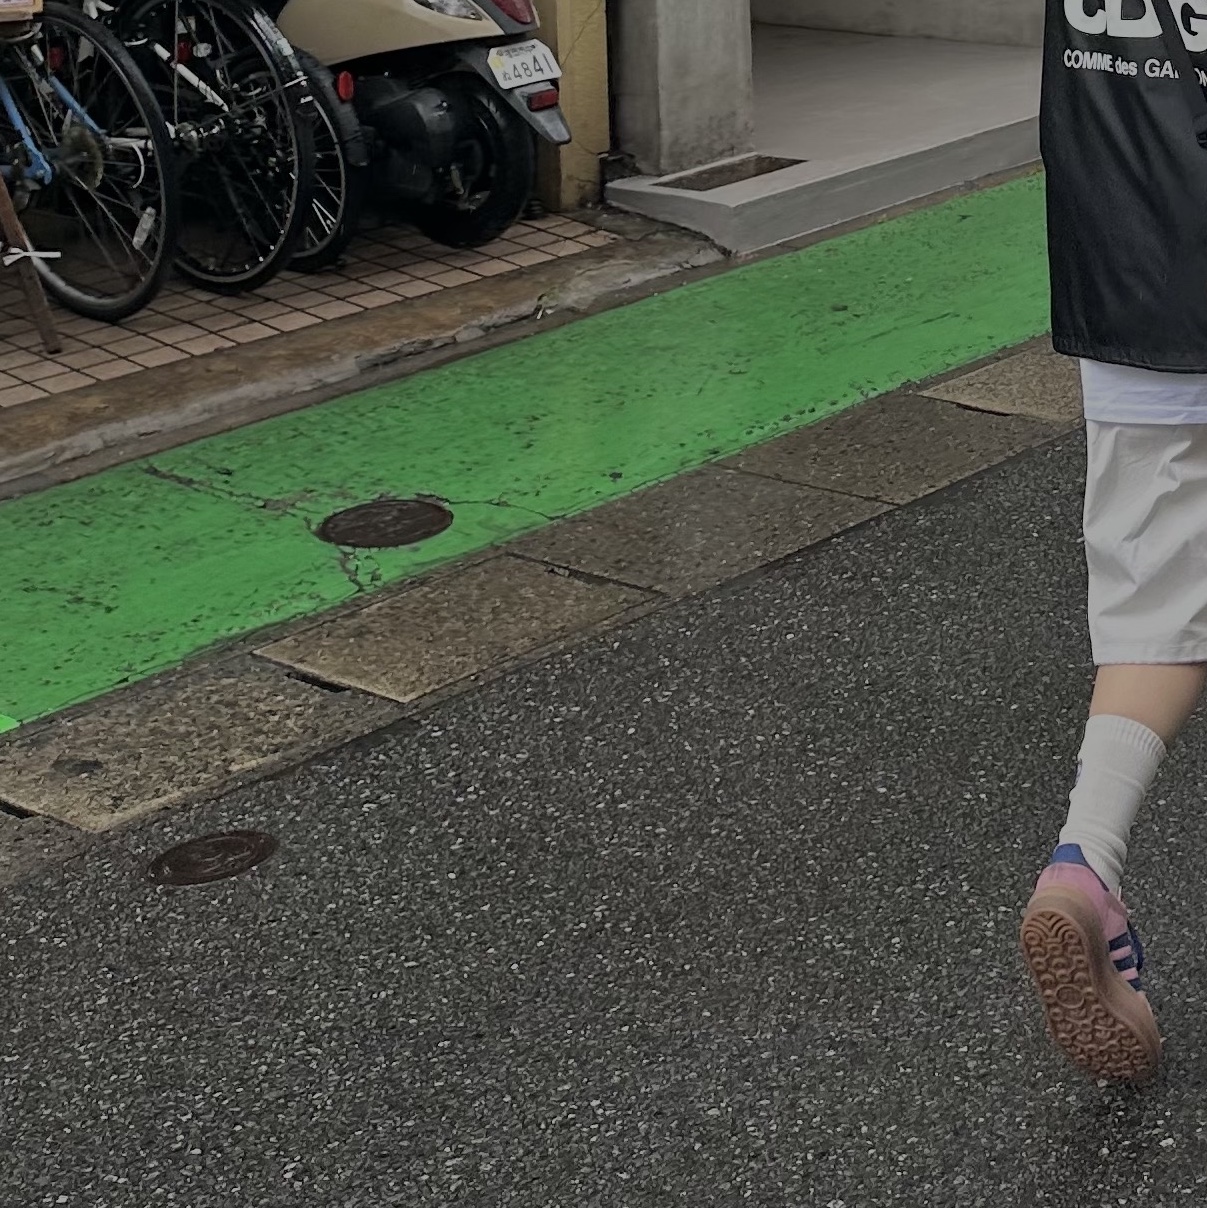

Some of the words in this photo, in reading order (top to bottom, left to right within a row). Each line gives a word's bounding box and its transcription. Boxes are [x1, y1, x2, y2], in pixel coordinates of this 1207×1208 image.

[513, 53, 554, 80] 4841
[1063, 48, 1114, 73] COMME
[1115, 56, 1138, 77] des
